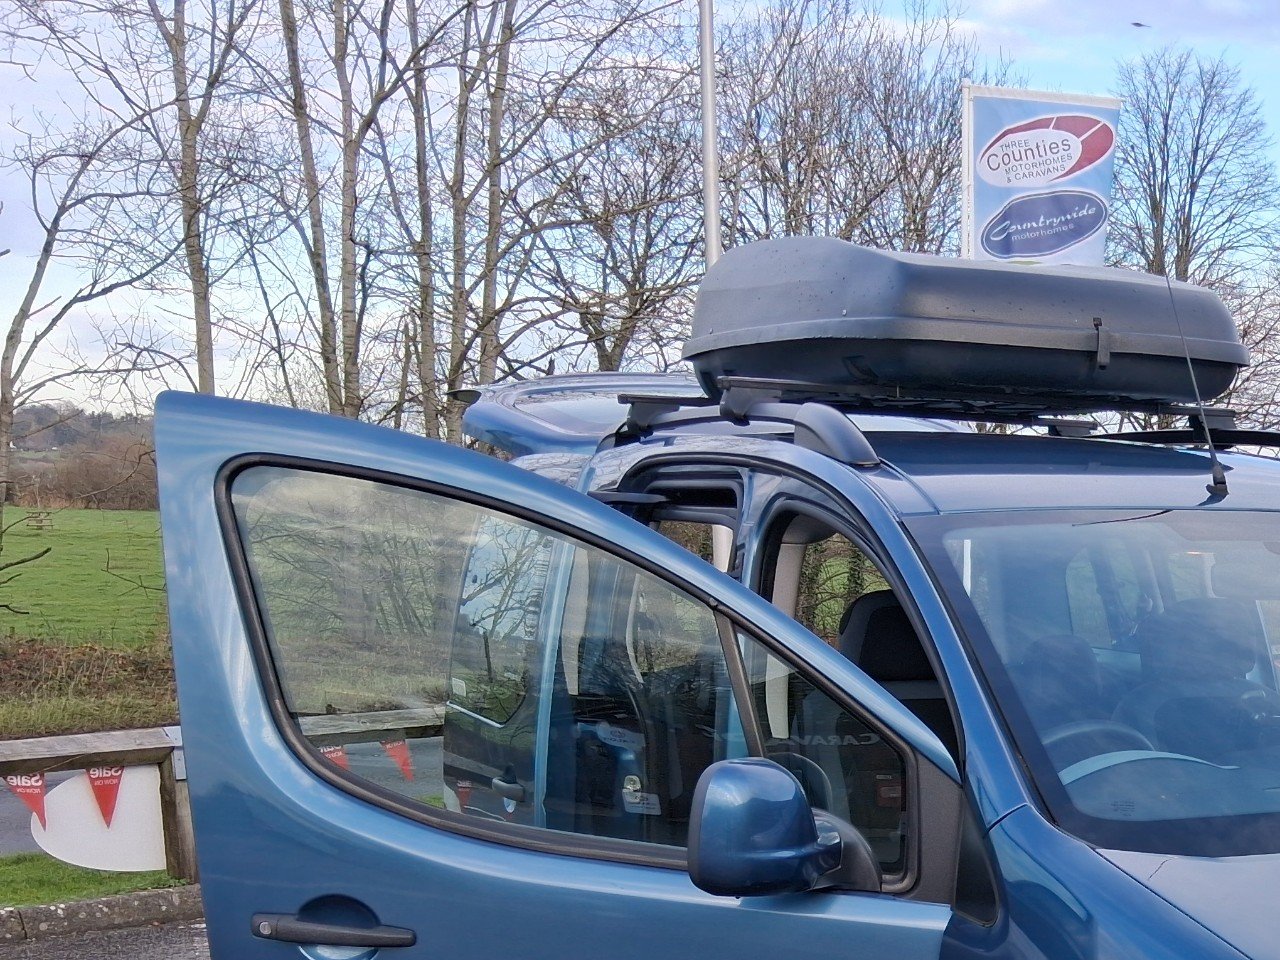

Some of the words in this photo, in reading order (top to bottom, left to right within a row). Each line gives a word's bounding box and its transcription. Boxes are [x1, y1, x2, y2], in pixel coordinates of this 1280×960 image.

[987, 139, 1071, 171] Counties
[1000, 139, 1031, 153] THREE
[1005, 153, 1073, 175] MOTORHOMES
[1015, 164, 1066, 181] CARAVANS
[990, 203, 1096, 241] Countrywide
[1012, 223, 1075, 241] motorhomes
